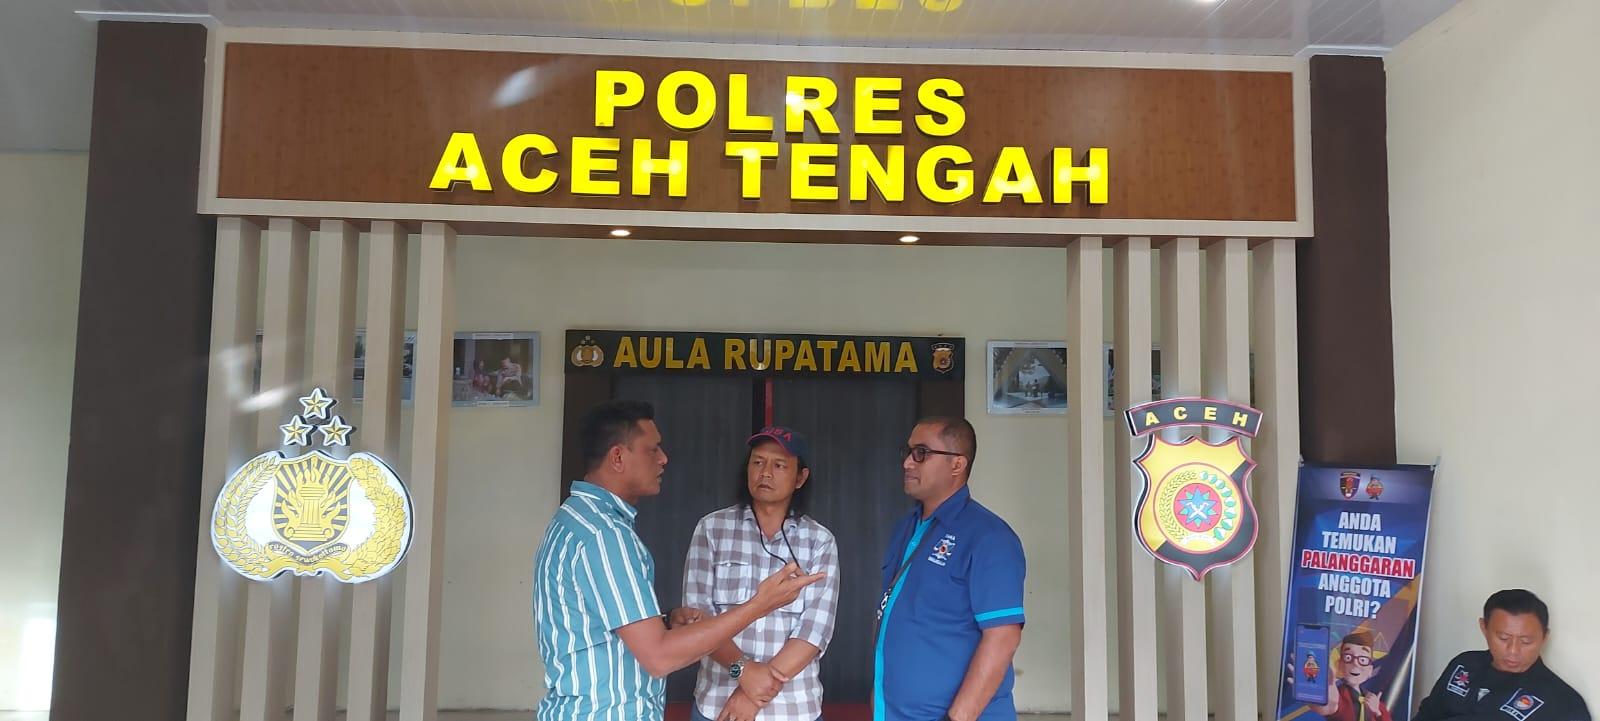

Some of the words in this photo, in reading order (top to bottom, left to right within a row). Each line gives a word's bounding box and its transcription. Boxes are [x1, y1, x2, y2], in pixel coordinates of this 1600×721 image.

[594, 69, 967, 136] POLRES
[428, 132, 690, 199] ACEH
[725, 140, 1110, 205] TENGAH
[613, 335, 711, 371] AULA
[724, 337, 919, 374] RUPATAMA
[1145, 406, 1248, 428] ACEH
[1338, 511, 1382, 532] ANDA
[1322, 531, 1397, 554] TEMUKAN
[1301, 549, 1415, 579] PALANGGARAN
[1318, 573, 1391, 598] ANGGOTA
[1324, 595, 1382, 619] POLRI?
